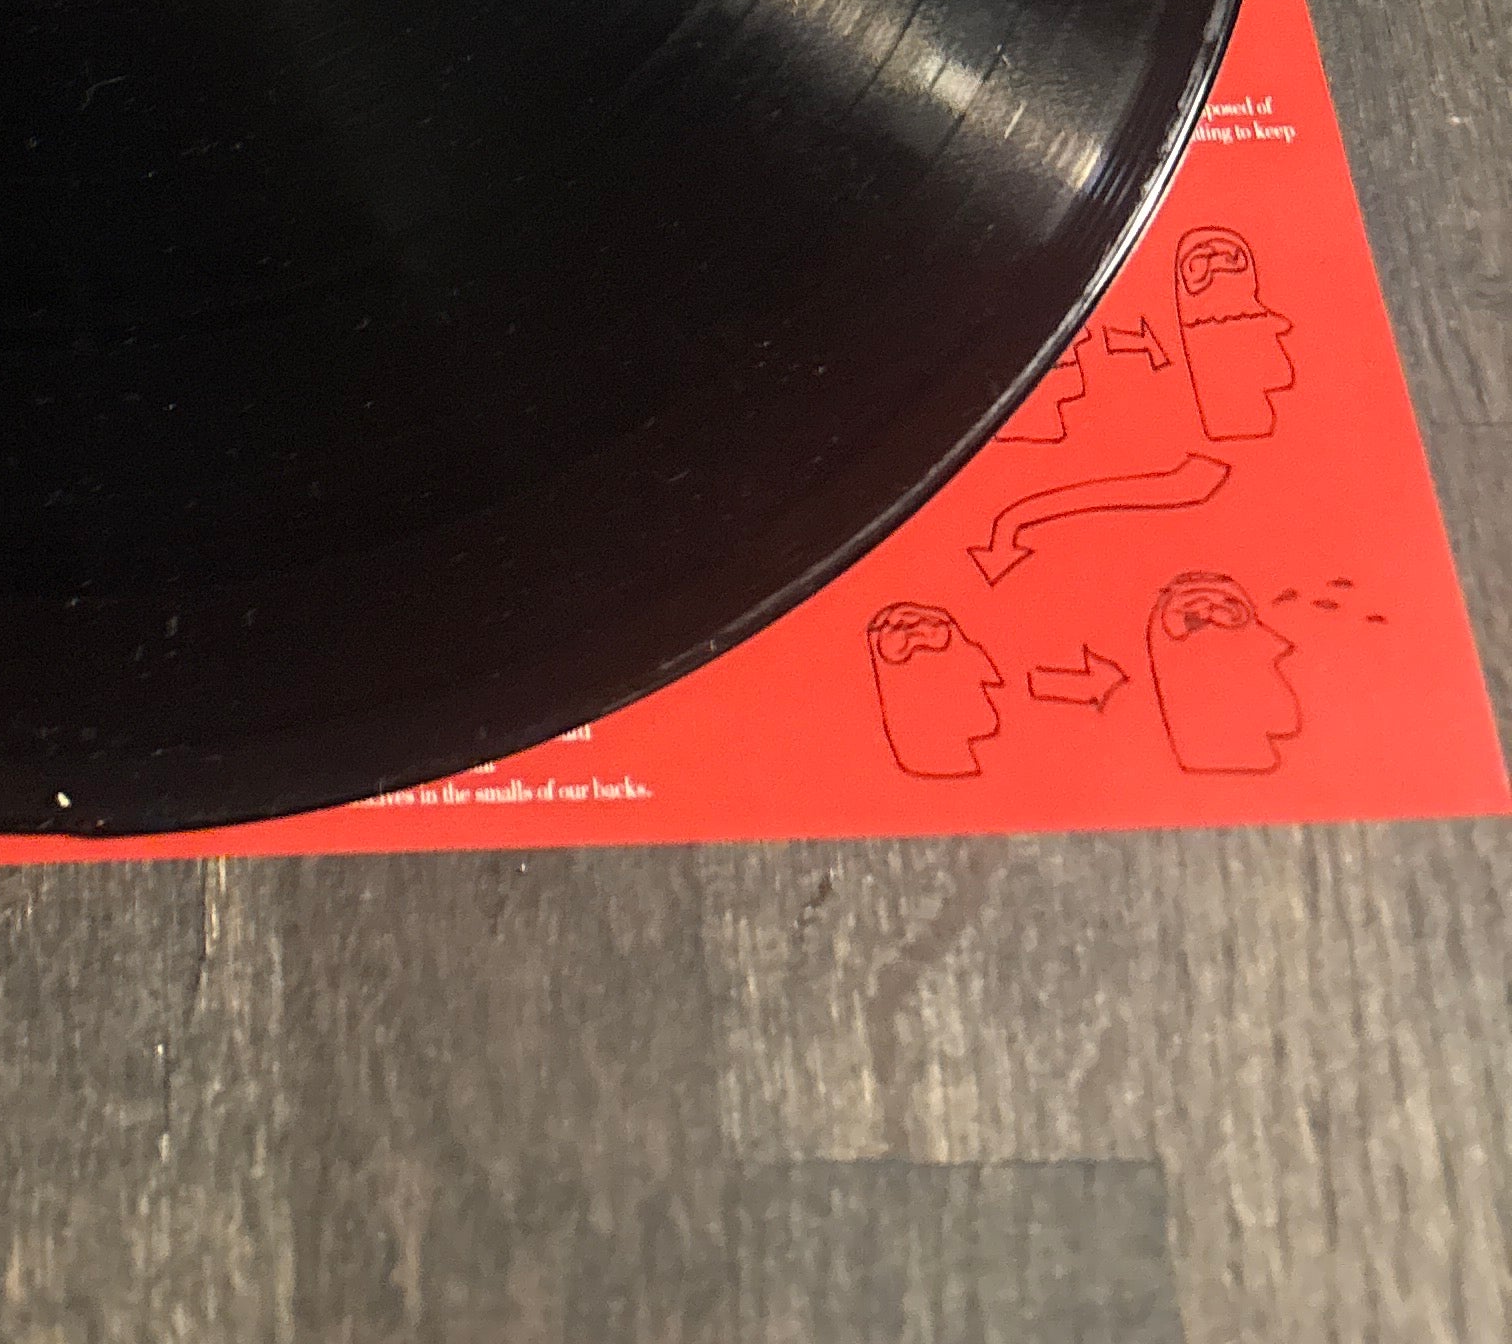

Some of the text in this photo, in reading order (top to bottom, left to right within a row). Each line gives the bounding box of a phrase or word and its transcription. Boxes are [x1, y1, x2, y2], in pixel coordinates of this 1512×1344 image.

[1256, 95, 1273, 114] of
[1234, 120, 1296, 143] to keep
[419, 777, 652, 803] in the smalls of our backs.
